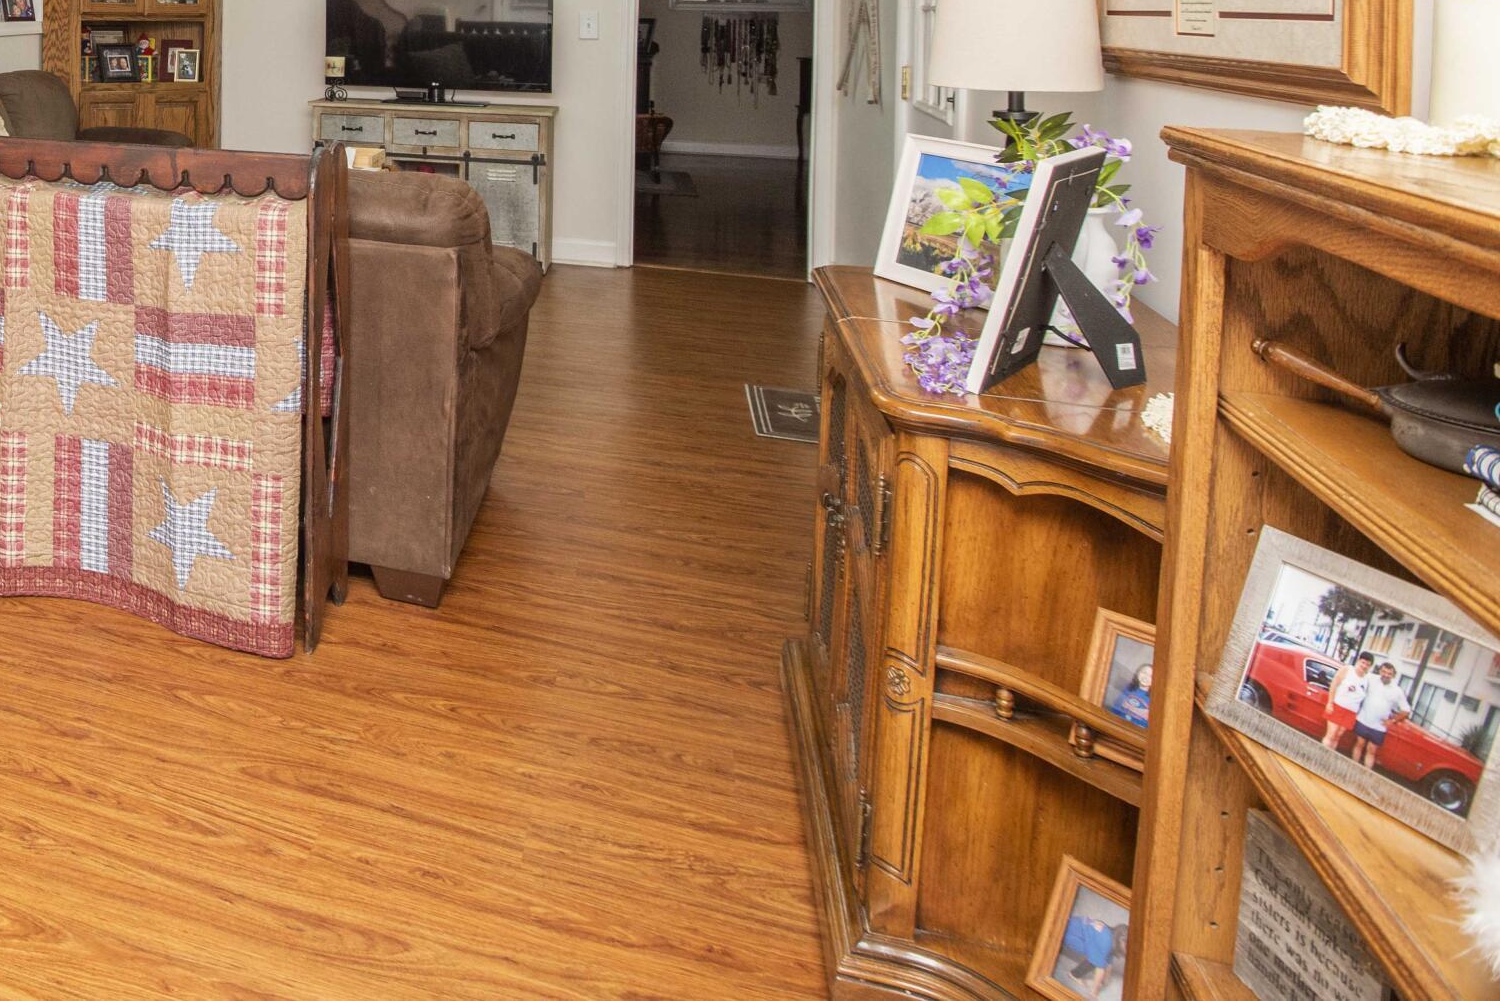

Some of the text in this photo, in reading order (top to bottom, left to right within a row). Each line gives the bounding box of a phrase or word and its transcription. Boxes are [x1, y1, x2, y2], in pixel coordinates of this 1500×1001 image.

[1256, 846, 1281, 881] The
[1284, 876, 1313, 916] only
[1251, 909, 1330, 990] there was no
[1252, 891, 1363, 998] sisters is because
